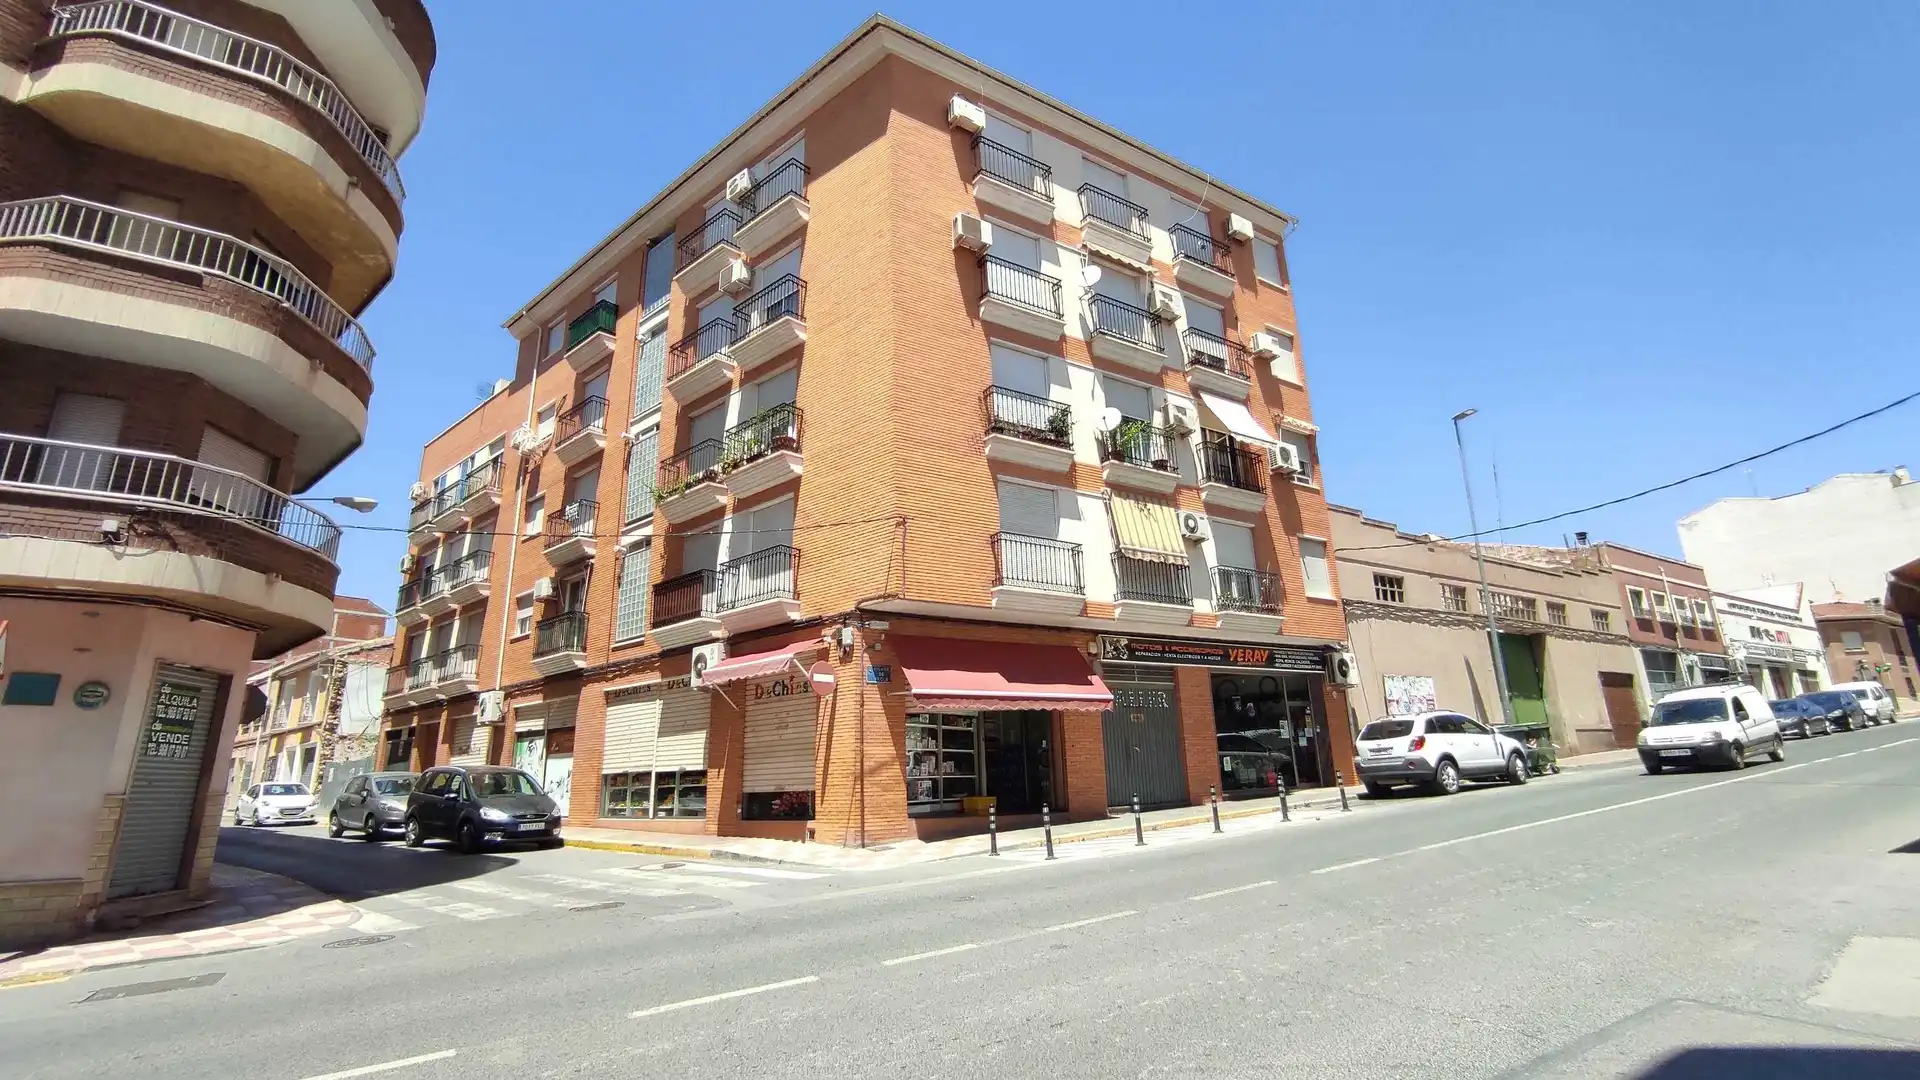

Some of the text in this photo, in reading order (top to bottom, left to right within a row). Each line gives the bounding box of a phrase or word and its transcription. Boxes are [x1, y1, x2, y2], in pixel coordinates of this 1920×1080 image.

[1228, 648, 1269, 662] YERAY
[159, 693, 197, 707] ALQUILA
[151, 732, 190, 744] VENDE
